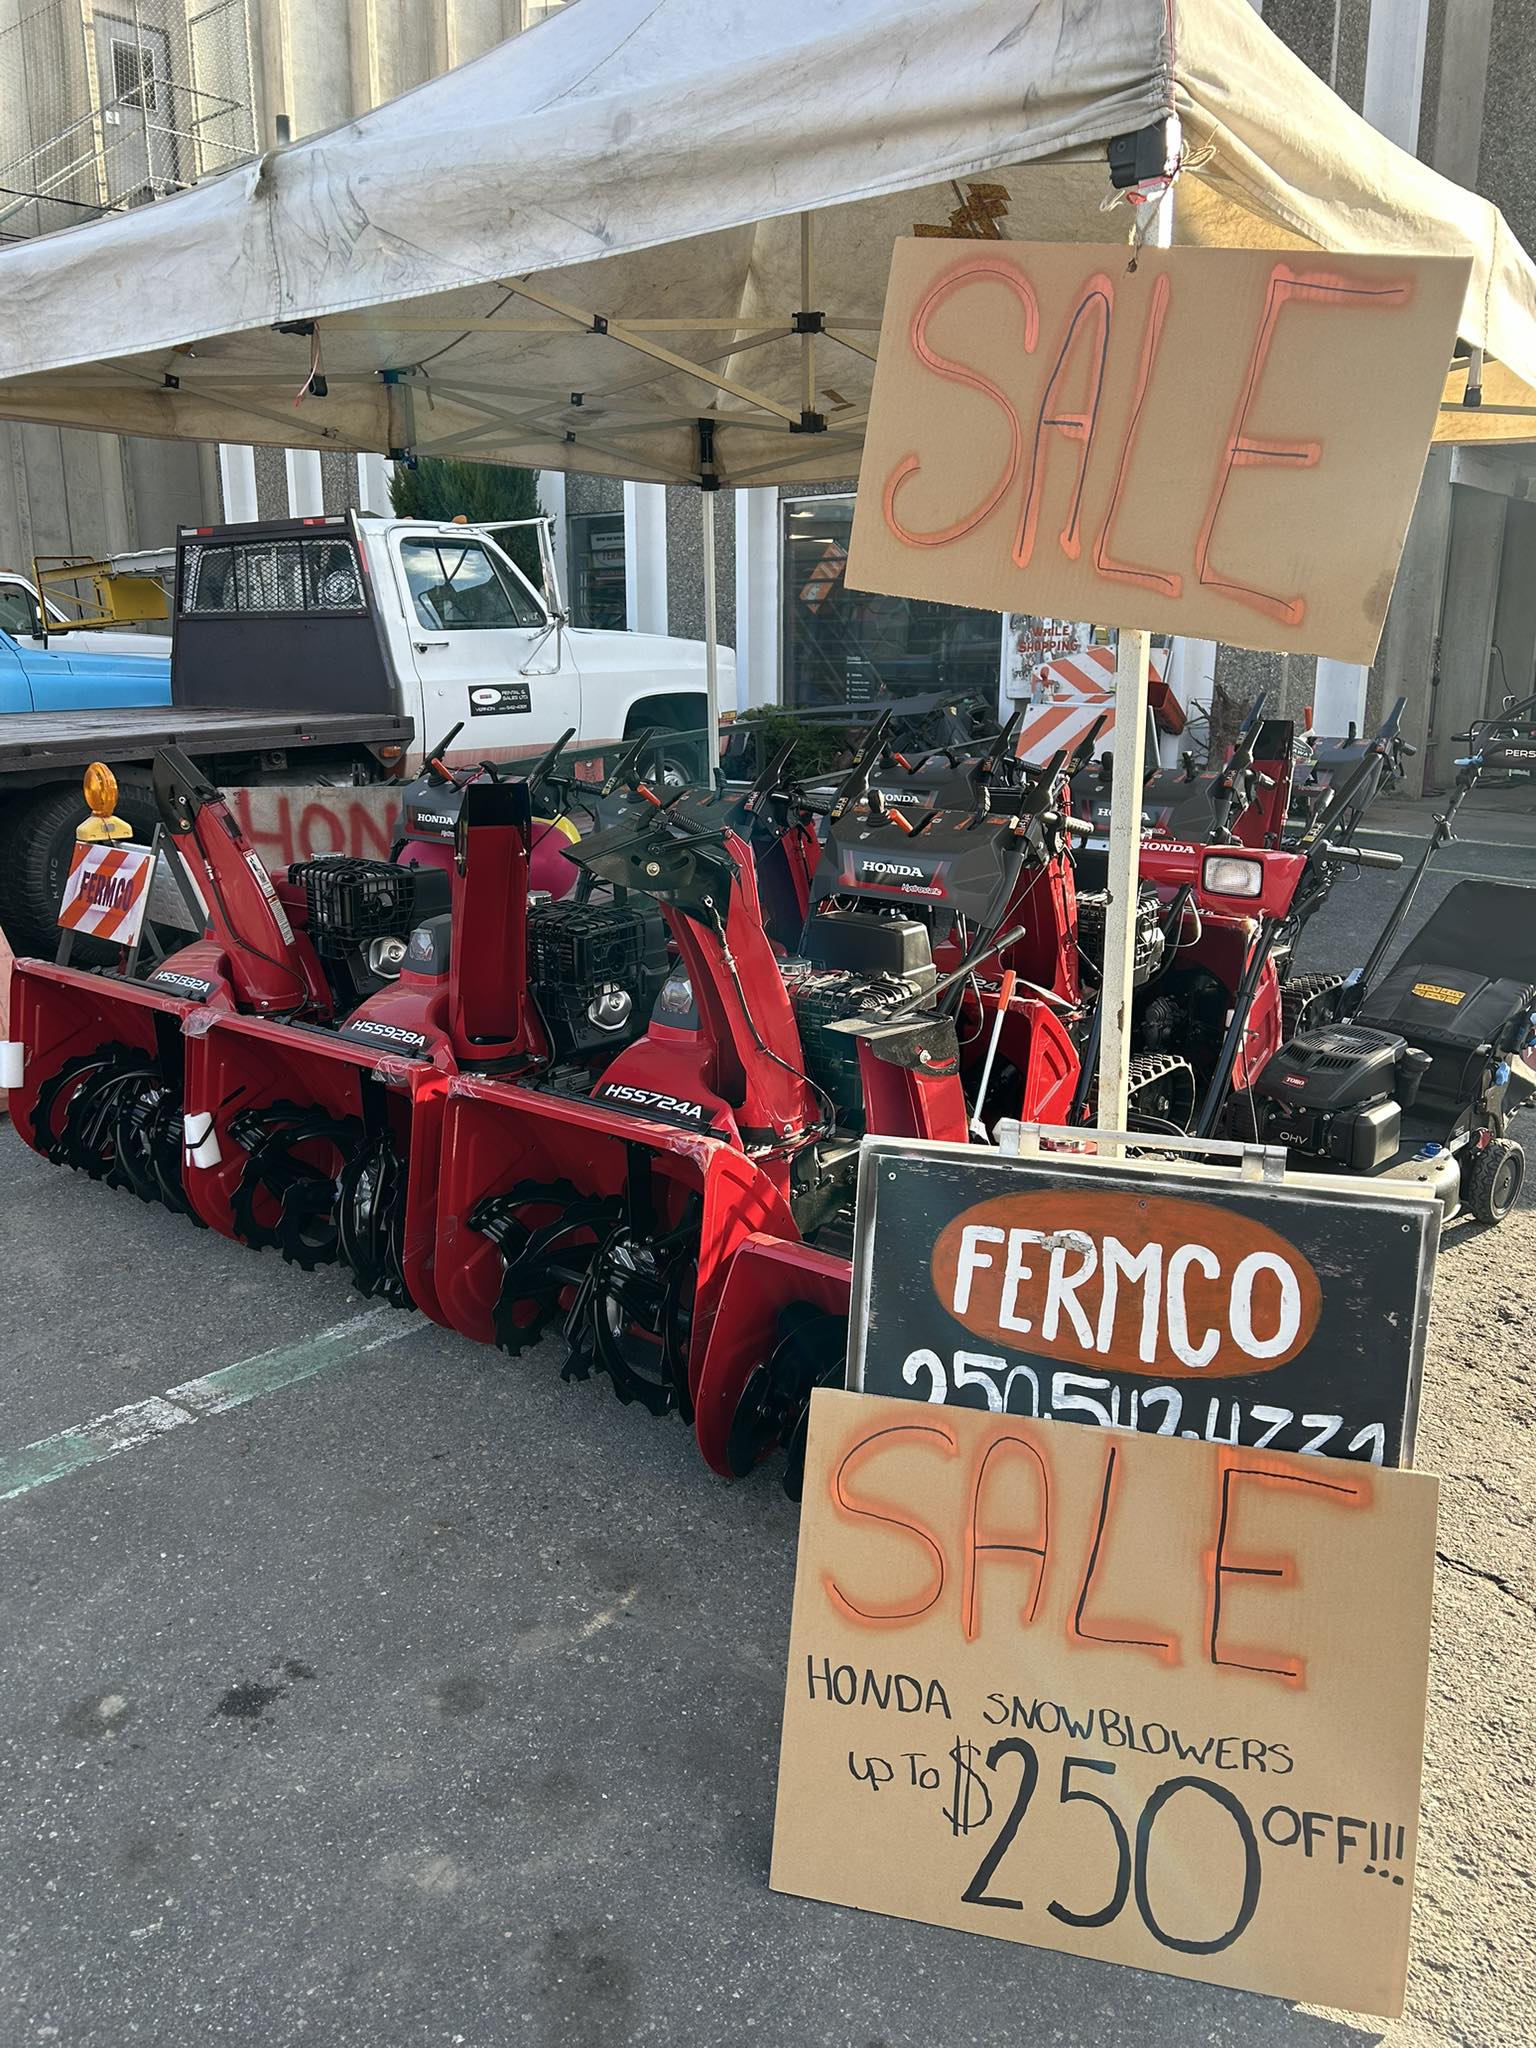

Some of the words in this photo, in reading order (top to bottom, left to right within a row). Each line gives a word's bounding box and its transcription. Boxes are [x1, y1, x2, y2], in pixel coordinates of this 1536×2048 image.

[884, 254, 1413, 625] SALE
[1031, 626, 1070, 637] WHILE
[1017, 640, 1078, 653] SHOPPING
[1505, 749, 1536, 758] PERS
[883, 793, 920, 804] ONDA
[417, 813, 455, 826] HONDA
[862, 860, 924, 878] HONDA
[79, 870, 134, 912] FERMCO
[155, 970, 211, 993] HSS1332A
[351, 1020, 426, 1047] HSS928A
[1286, 1077, 1305, 1086] TORO
[604, 1083, 703, 1119] HSS724A
[1279, 1131, 1309, 1145] OHV
[952, 1225, 1301, 1368] FERMCO
[822, 1416, 1373, 1691] SALE
[806, 1654, 952, 1720] HONDA
[983, 1692, 1295, 1775] SNOWBLOWERS
[942, 1734, 1262, 1955] $250
[1262, 1805, 1405, 1886] OFF!!!
